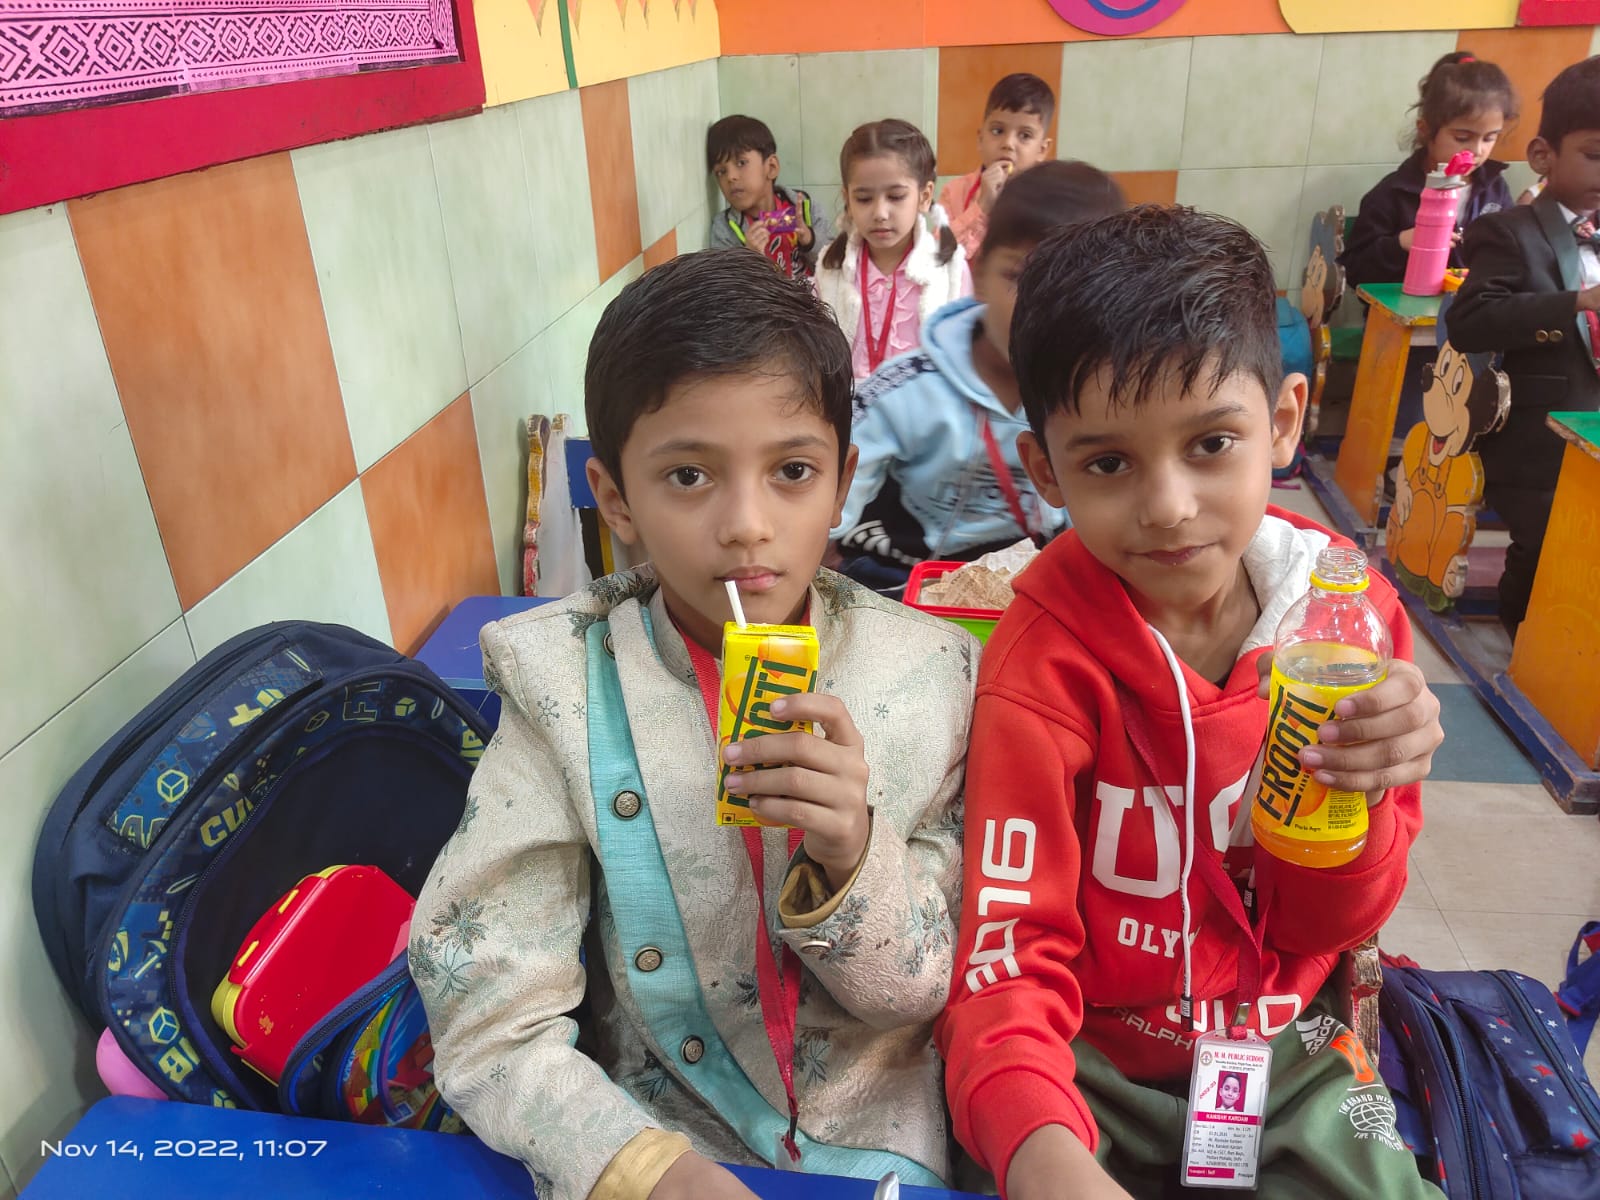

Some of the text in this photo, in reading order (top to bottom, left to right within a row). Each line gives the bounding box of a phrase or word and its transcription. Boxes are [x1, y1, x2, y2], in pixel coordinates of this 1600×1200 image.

[1257, 691, 1328, 821] FROOTI
[1117, 916, 1201, 958] OLY
[1309, 1014, 1337, 1056] adida
